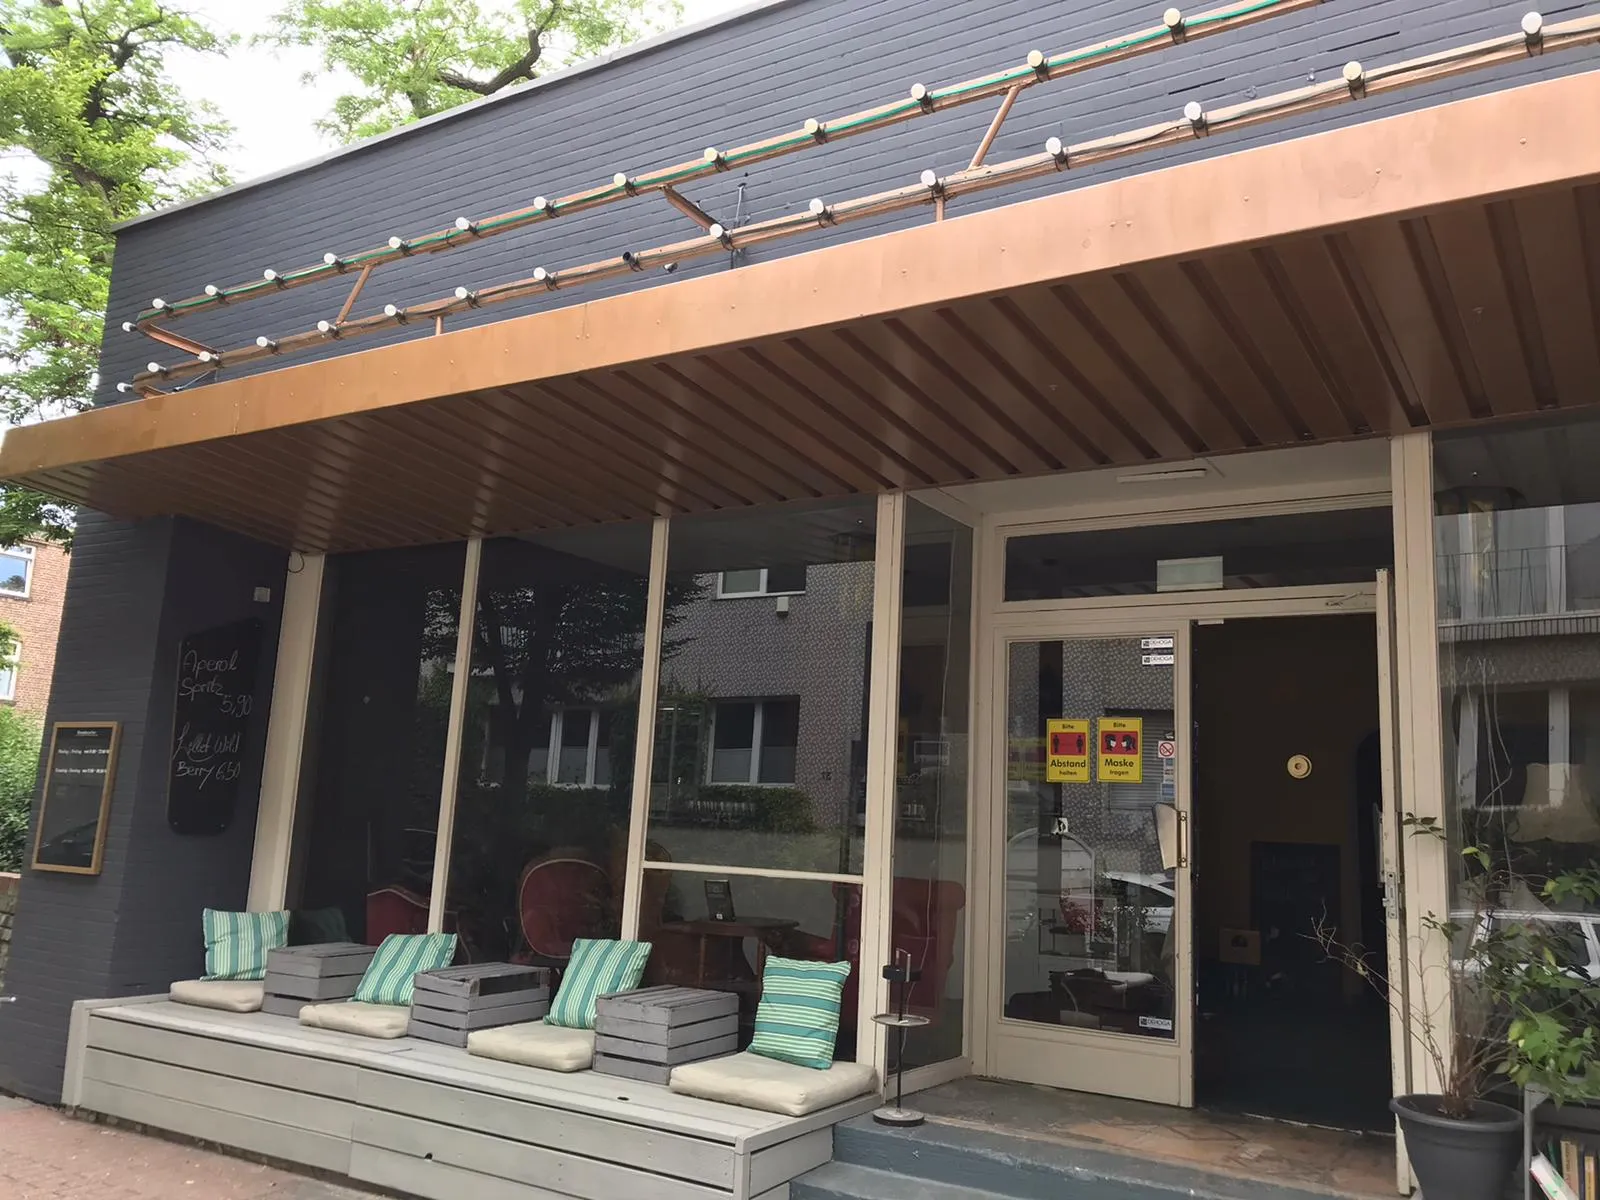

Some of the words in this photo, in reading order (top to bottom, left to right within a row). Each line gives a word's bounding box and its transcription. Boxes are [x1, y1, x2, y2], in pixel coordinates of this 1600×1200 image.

[183, 649, 238, 679] Aperol
[179, 674, 224, 702] Spritz
[175, 761, 216, 791] Berry
[1050, 760, 1086, 768] Abstand
[1104, 759, 1134, 767] Maske
